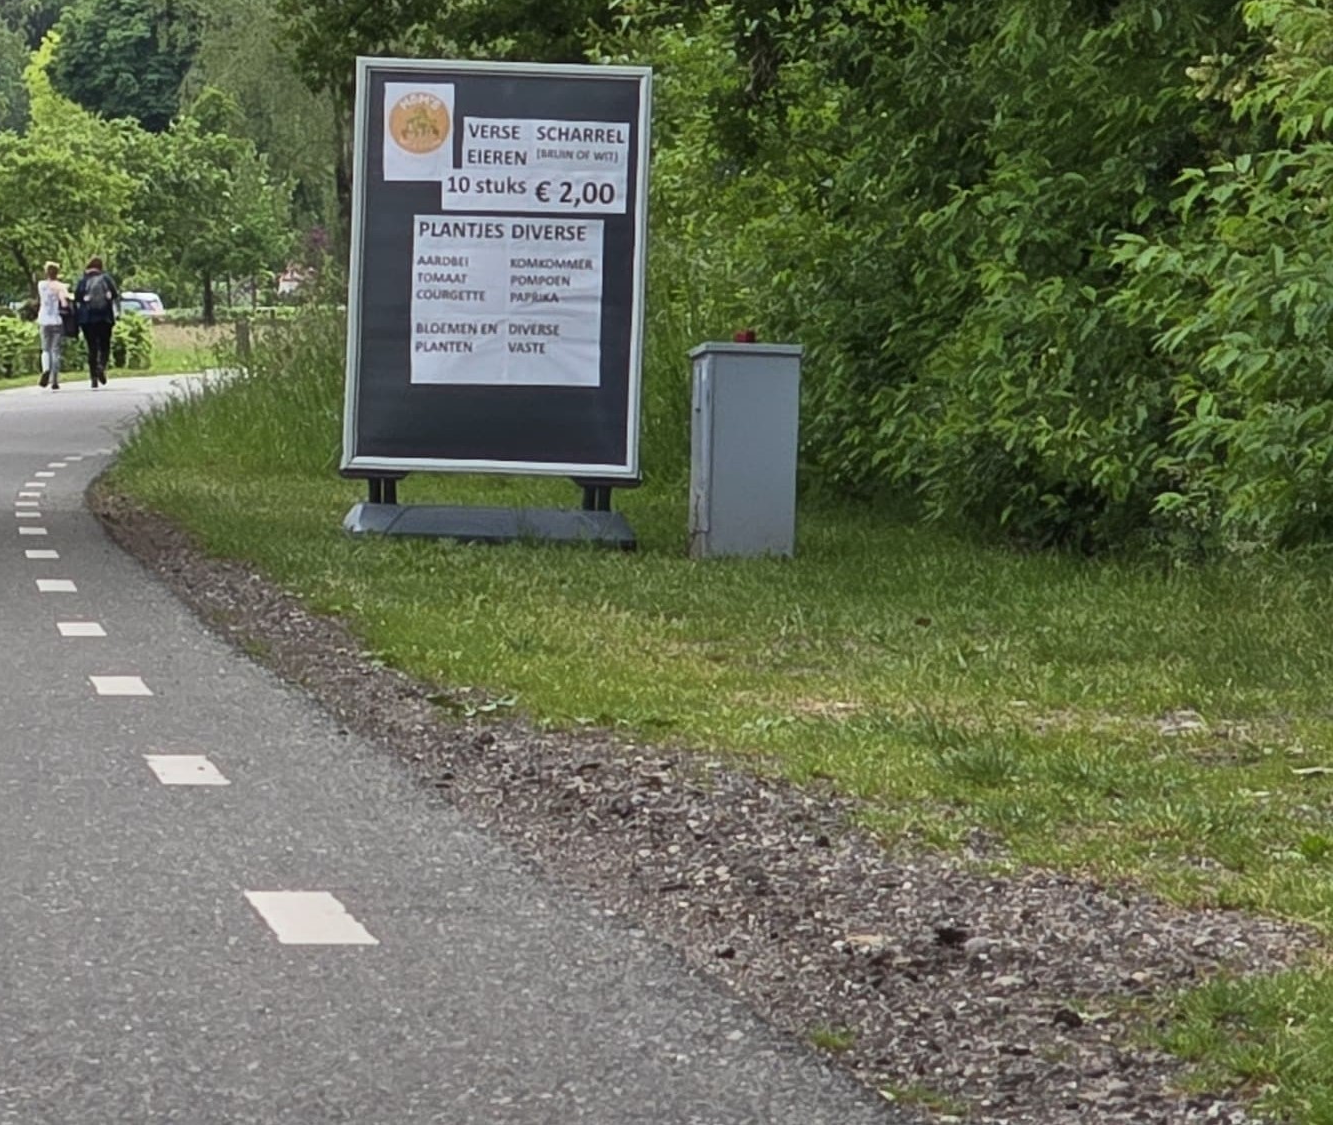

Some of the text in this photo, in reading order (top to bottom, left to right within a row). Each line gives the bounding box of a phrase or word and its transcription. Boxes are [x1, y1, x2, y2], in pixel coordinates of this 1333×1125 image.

[468, 123, 625, 144] VERSE SCHARREL
[467, 149, 528, 166] EIEREN
[576, 149, 590, 160] OF
[447, 176, 615, 208] 10 stuks € 2,00
[419, 221, 587, 241] PLANTJES DIVERSE
[416, 255, 469, 267] AARDBEI
[510, 258, 593, 270] KOMKOMMER
[417, 272, 468, 284] TOMAAT
[510, 275, 571, 286] POMPOEN
[416, 289, 485, 302] COURGETTE
[510, 291, 559, 303] PAPRIKA
[415, 322, 498, 335] BLOEMEN EN
[508, 323, 560, 336] DIVERSE
[415, 341, 473, 353] PLANTEN
[507, 342, 546, 354] VASTE
